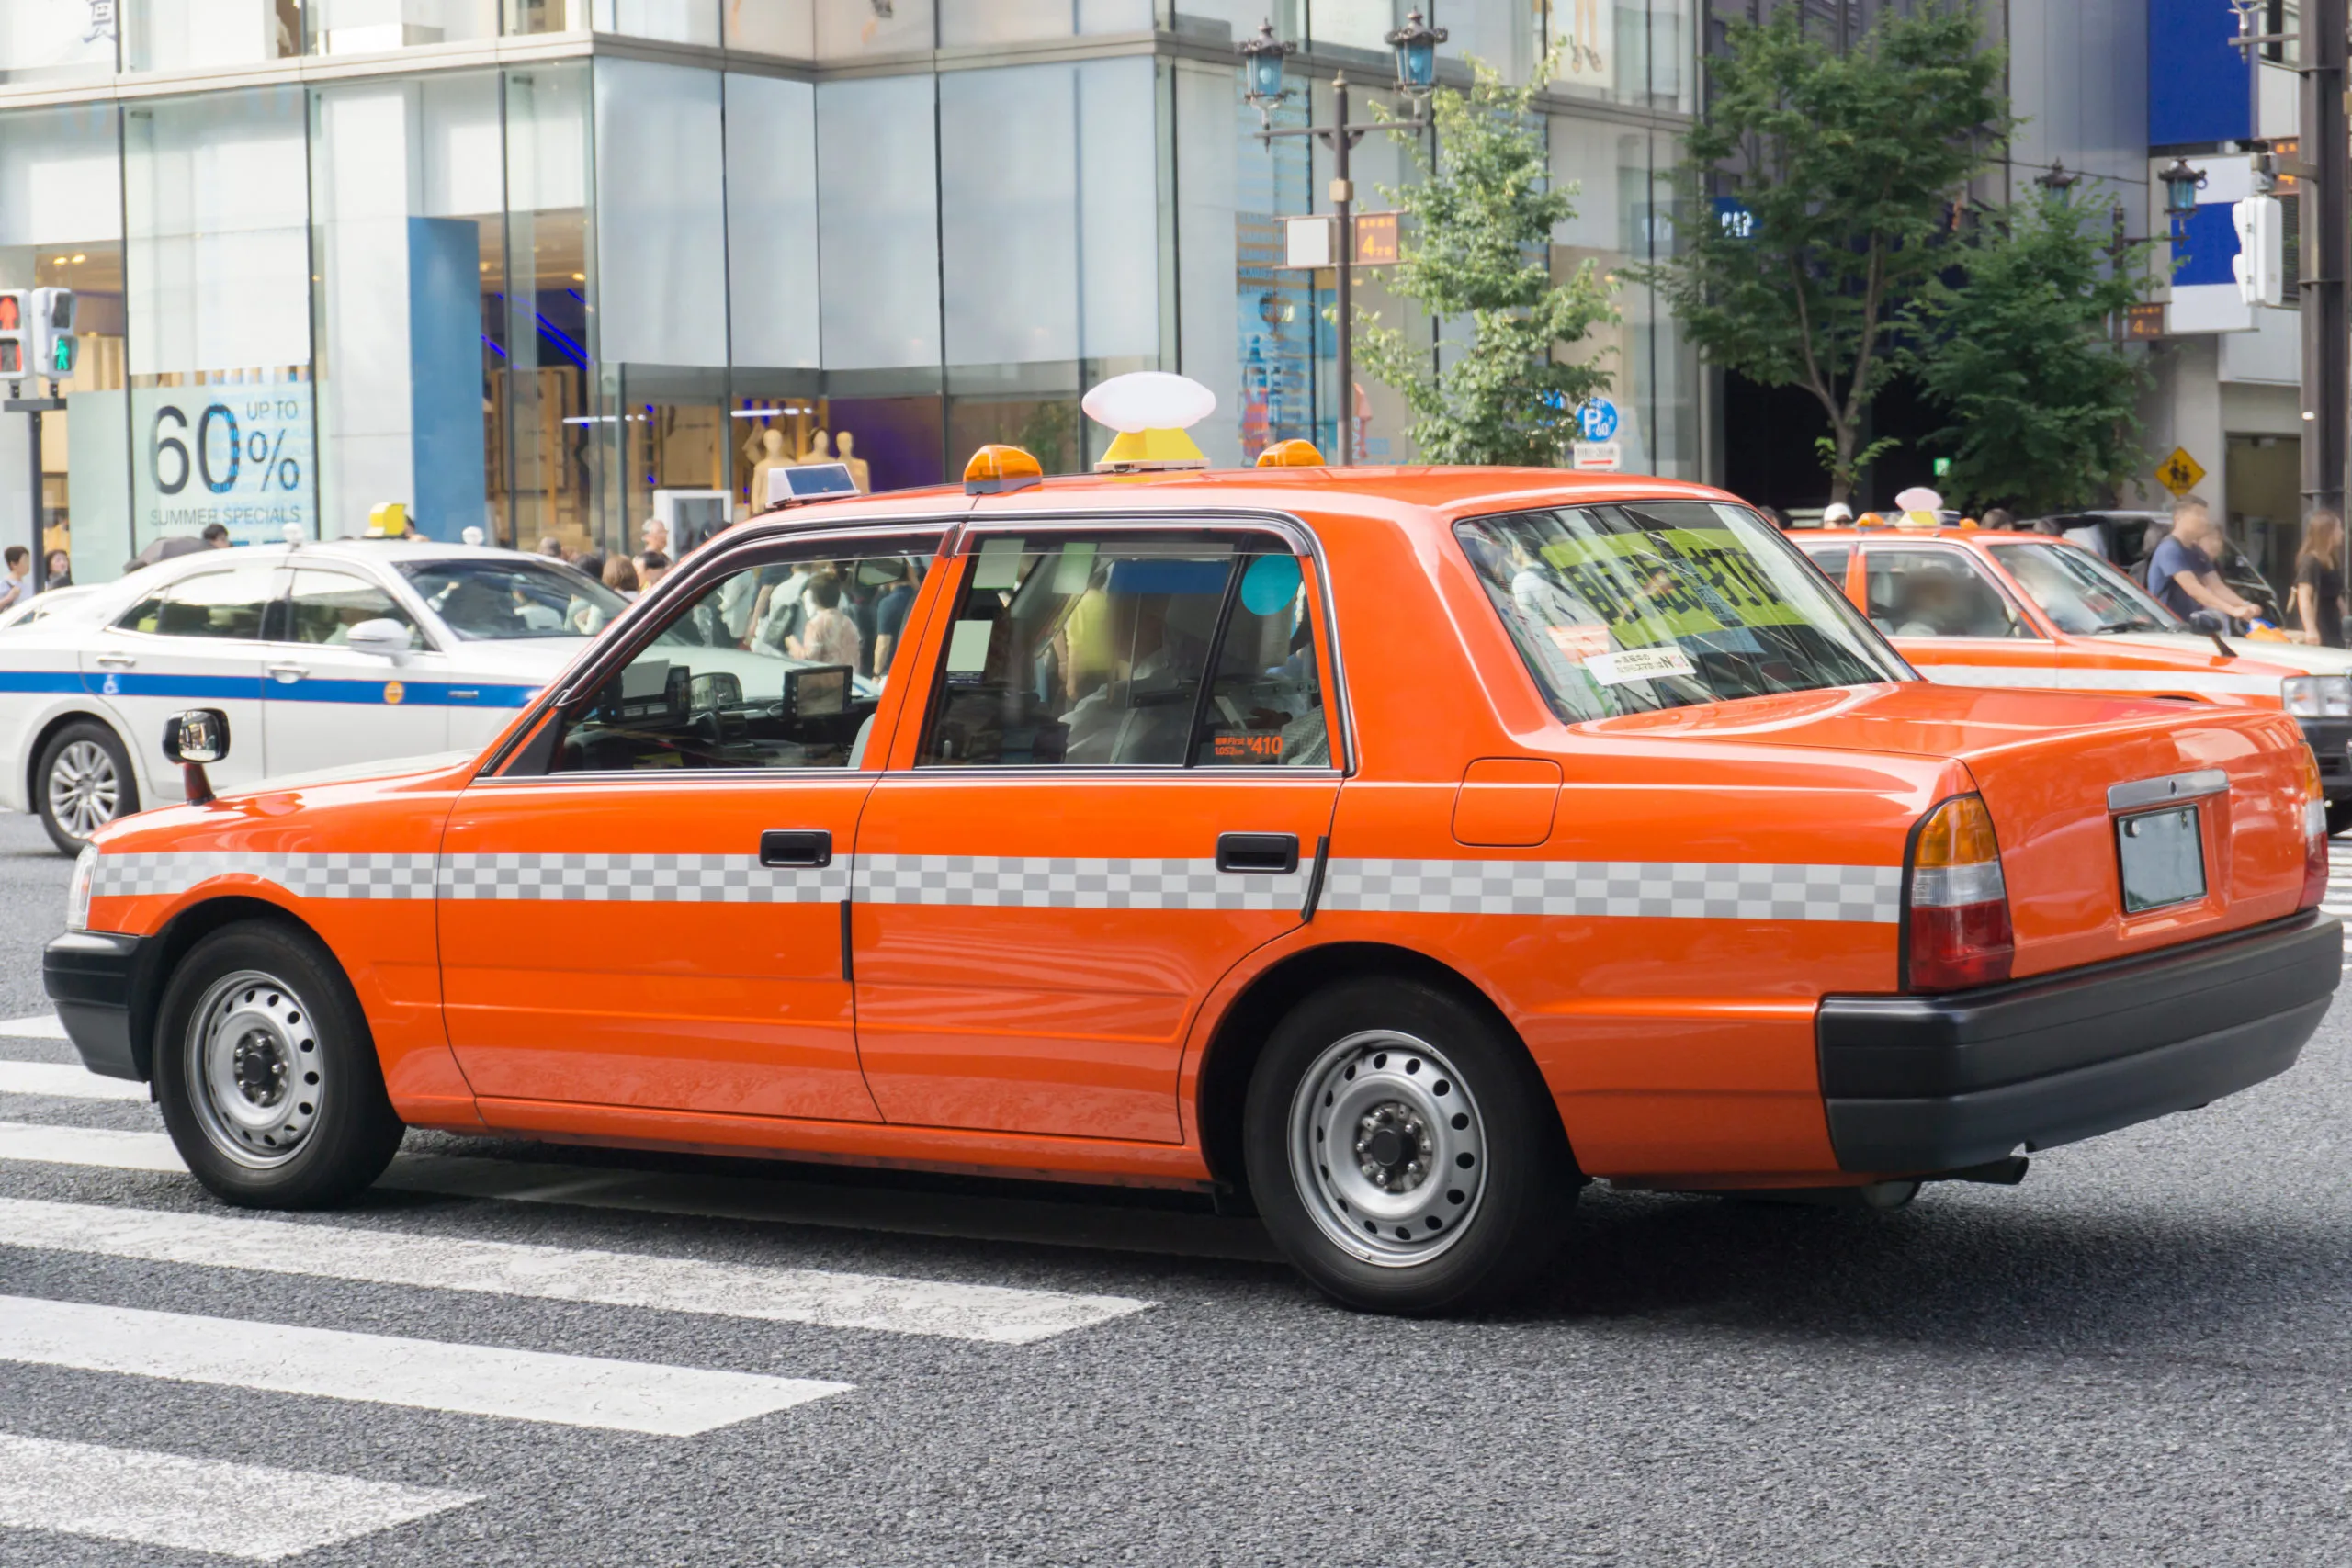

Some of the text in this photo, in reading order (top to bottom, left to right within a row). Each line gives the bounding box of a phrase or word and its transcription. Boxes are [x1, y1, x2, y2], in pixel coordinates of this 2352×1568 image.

[246, 400, 299, 421] UP TO
[1584, 408, 1602, 435] P
[150, 505, 302, 526] SUMMER SPECIALS
[1247, 736, 1283, 755] ¥410
